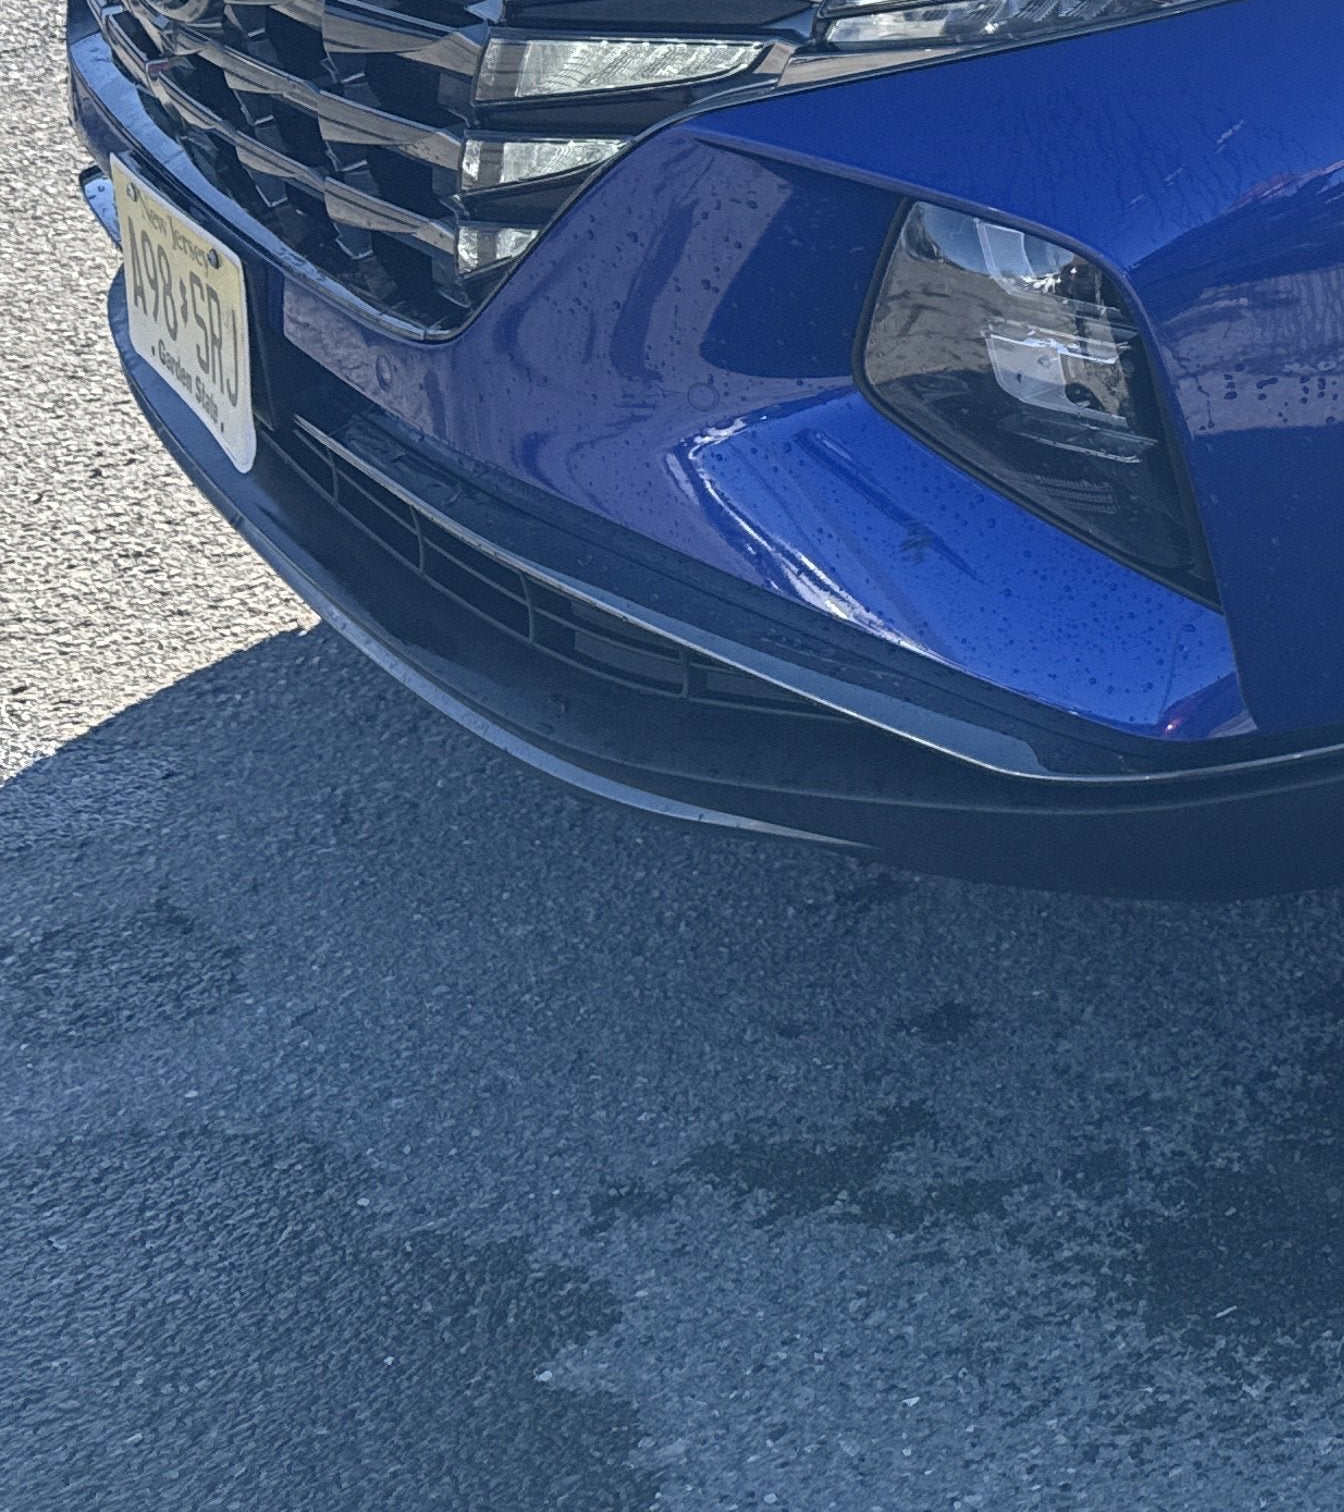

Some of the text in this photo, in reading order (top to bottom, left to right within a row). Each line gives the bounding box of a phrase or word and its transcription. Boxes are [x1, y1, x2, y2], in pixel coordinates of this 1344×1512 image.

[140, 194, 210, 277] New Jersey
[158, 338, 219, 425] Garden State
